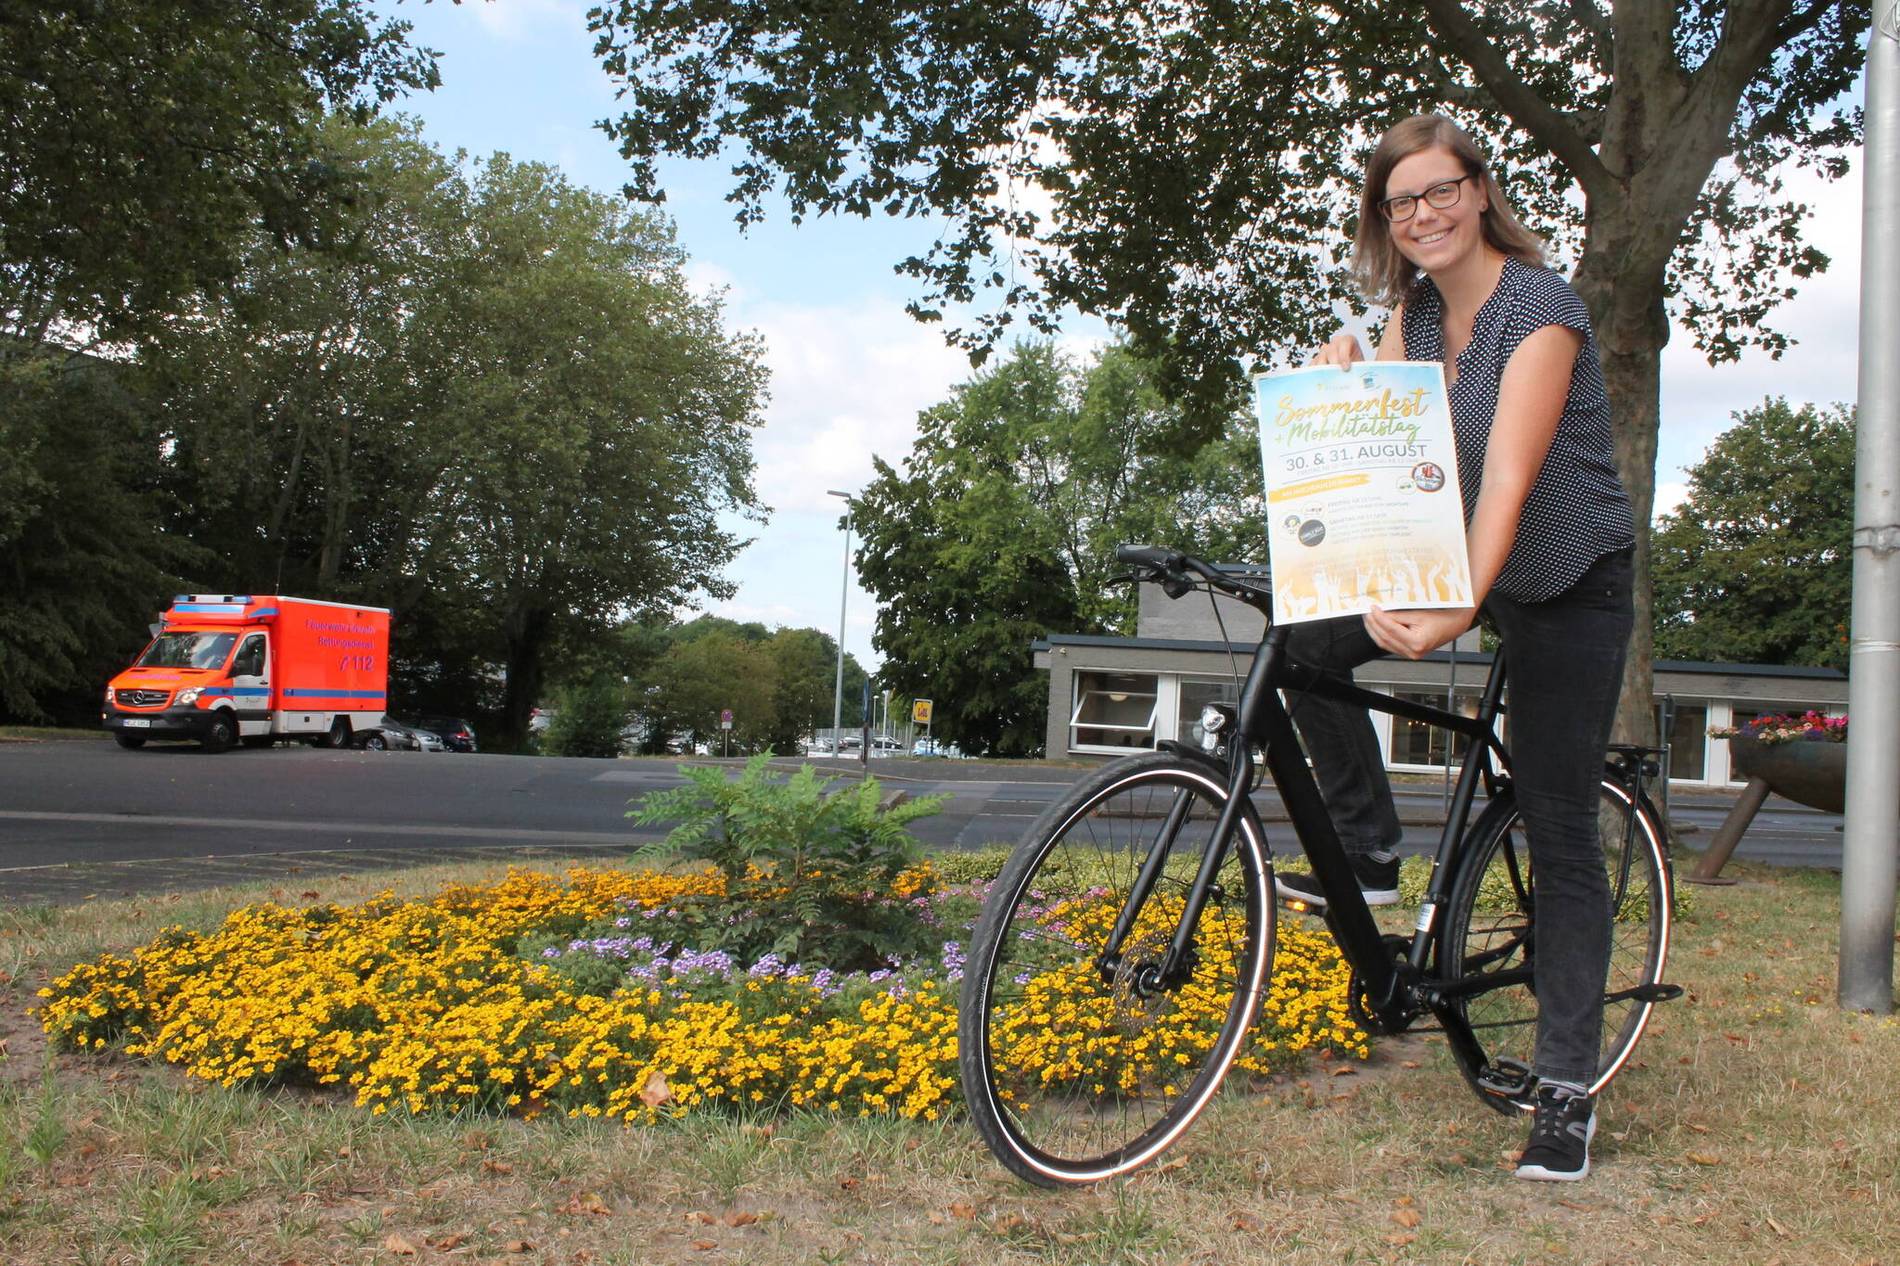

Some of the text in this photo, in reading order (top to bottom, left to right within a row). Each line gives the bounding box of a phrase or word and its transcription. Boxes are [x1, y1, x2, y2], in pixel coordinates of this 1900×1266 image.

[1275, 387, 1432, 427] Sommerfest
[1287, 413, 1422, 448] Mobilitätstag
[1286, 455, 1310, 472] 30.
[1313, 452, 1325, 466] &
[1330, 448, 1354, 462] 31.
[1357, 444, 1428, 459] AUGUST
[352, 655, 374, 672] 112
